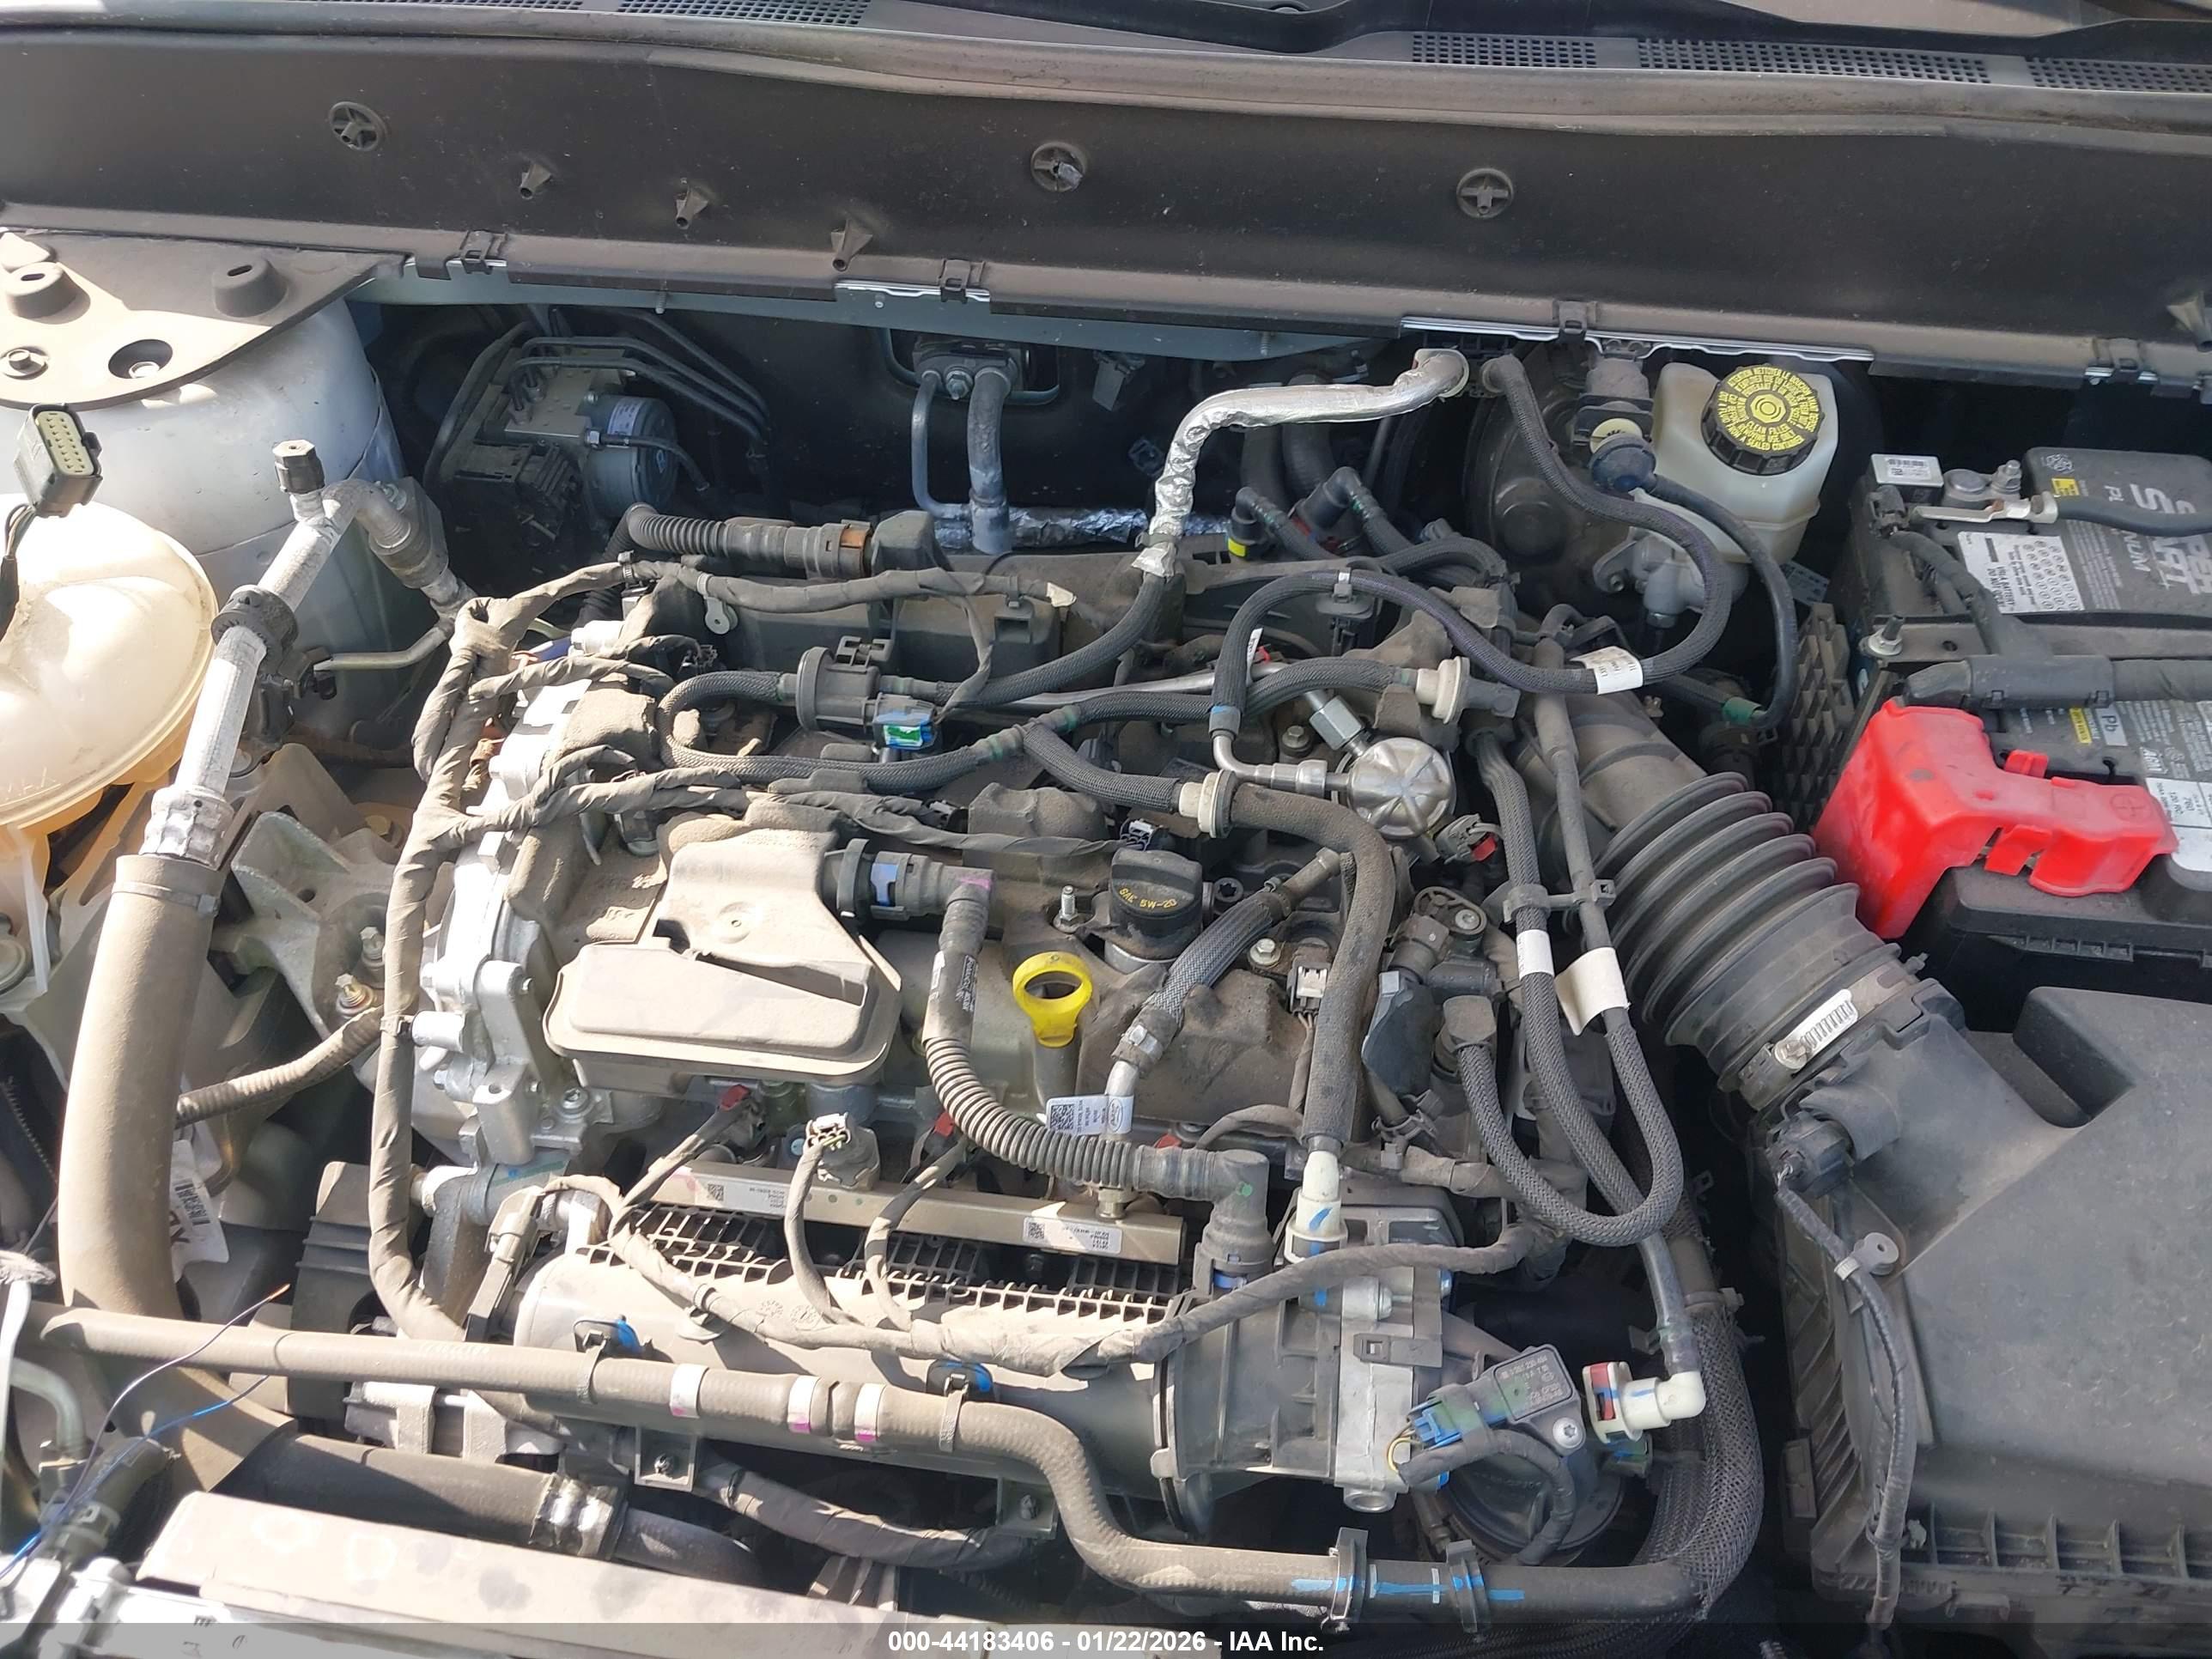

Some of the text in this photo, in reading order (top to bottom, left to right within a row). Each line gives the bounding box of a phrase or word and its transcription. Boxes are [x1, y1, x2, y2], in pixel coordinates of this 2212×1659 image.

[1781, 371, 1790, 380] LE
[1746, 421, 1766, 434] CLEAN
[2101, 715, 2119, 732] Pb
